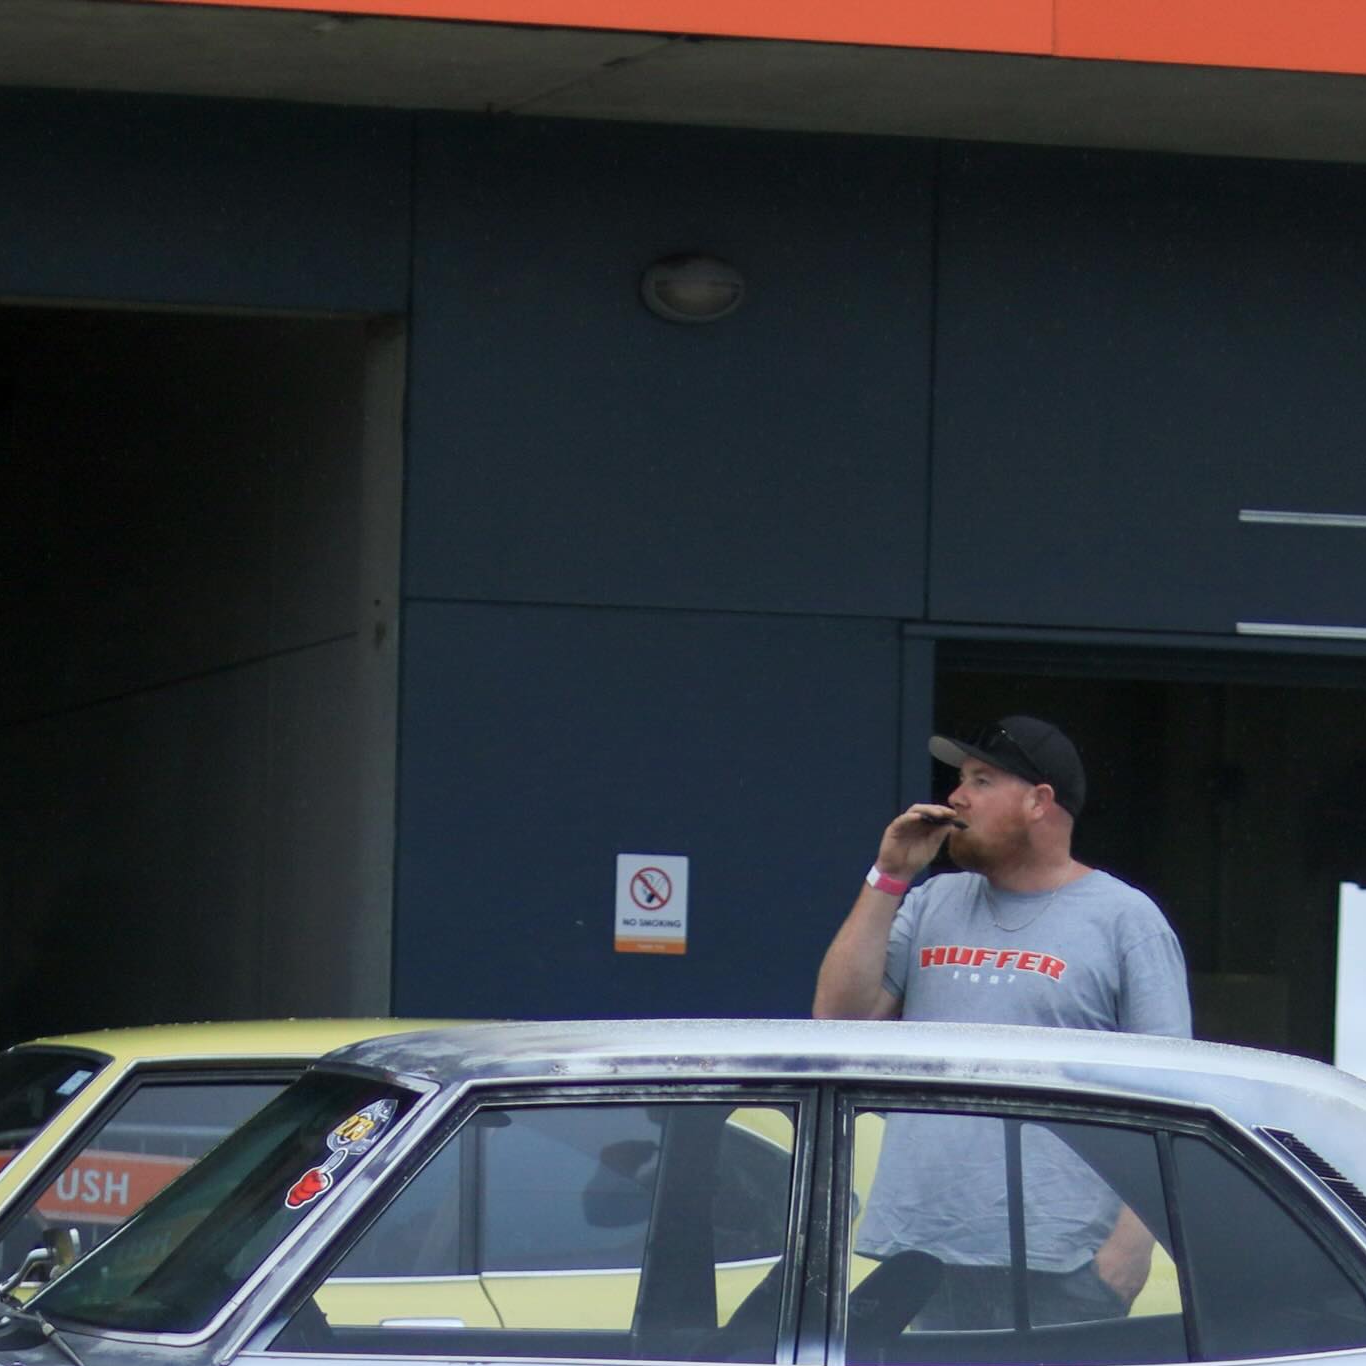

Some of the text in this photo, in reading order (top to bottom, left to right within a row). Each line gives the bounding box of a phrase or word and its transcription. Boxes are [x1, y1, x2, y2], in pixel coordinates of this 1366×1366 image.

[622, 918, 682, 928] NO SMOKING
[920, 946, 1067, 981] HUFFER
[56, 1167, 130, 1206] USH
